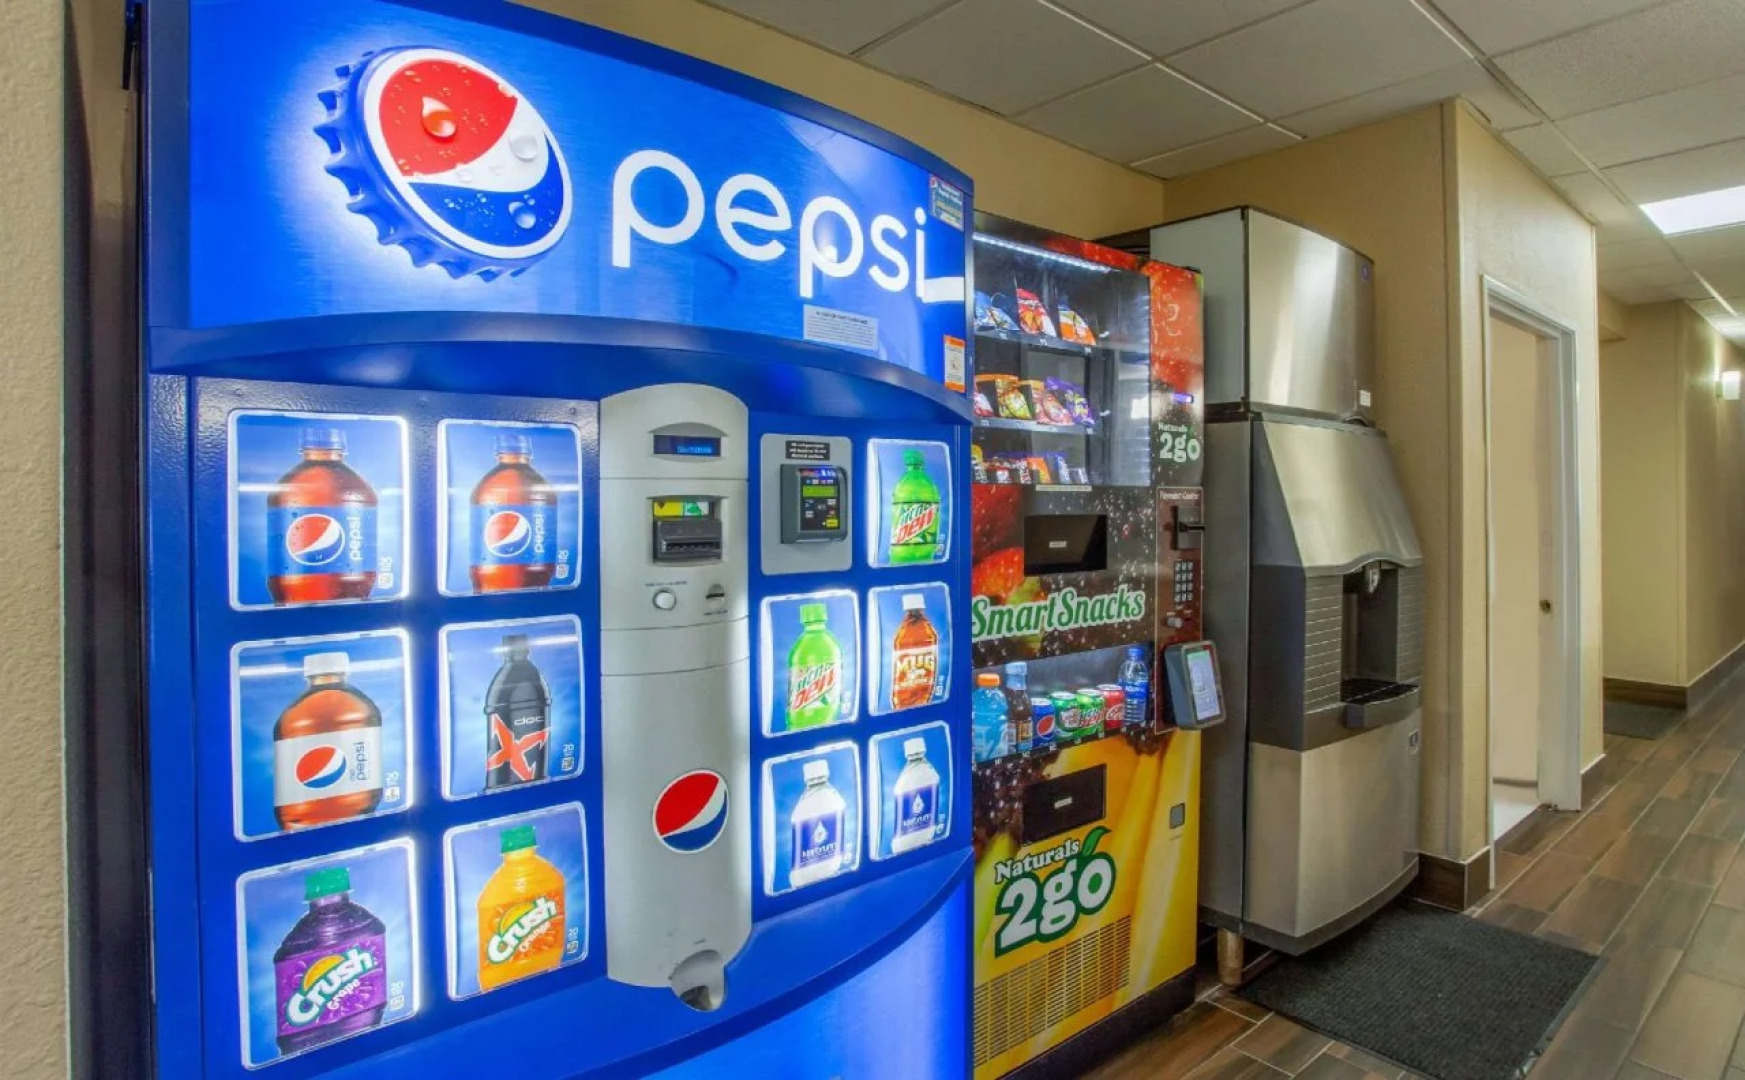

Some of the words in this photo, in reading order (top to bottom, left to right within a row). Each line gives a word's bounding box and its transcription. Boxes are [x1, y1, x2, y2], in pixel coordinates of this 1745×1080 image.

[611, 148, 929, 301] pepsi
[1159, 432, 1201, 463] 2go
[347, 515, 364, 561] pepsi
[532, 512, 545, 554] pepsi
[895, 653, 936, 673] MUG
[513, 714, 545, 727] doc
[353, 741, 369, 782] pepsi
[995, 839, 1080, 883] Naturals
[1000, 857, 1113, 950] 2go
[487, 896, 558, 963] Crush
[286, 947, 374, 1024] Crush
